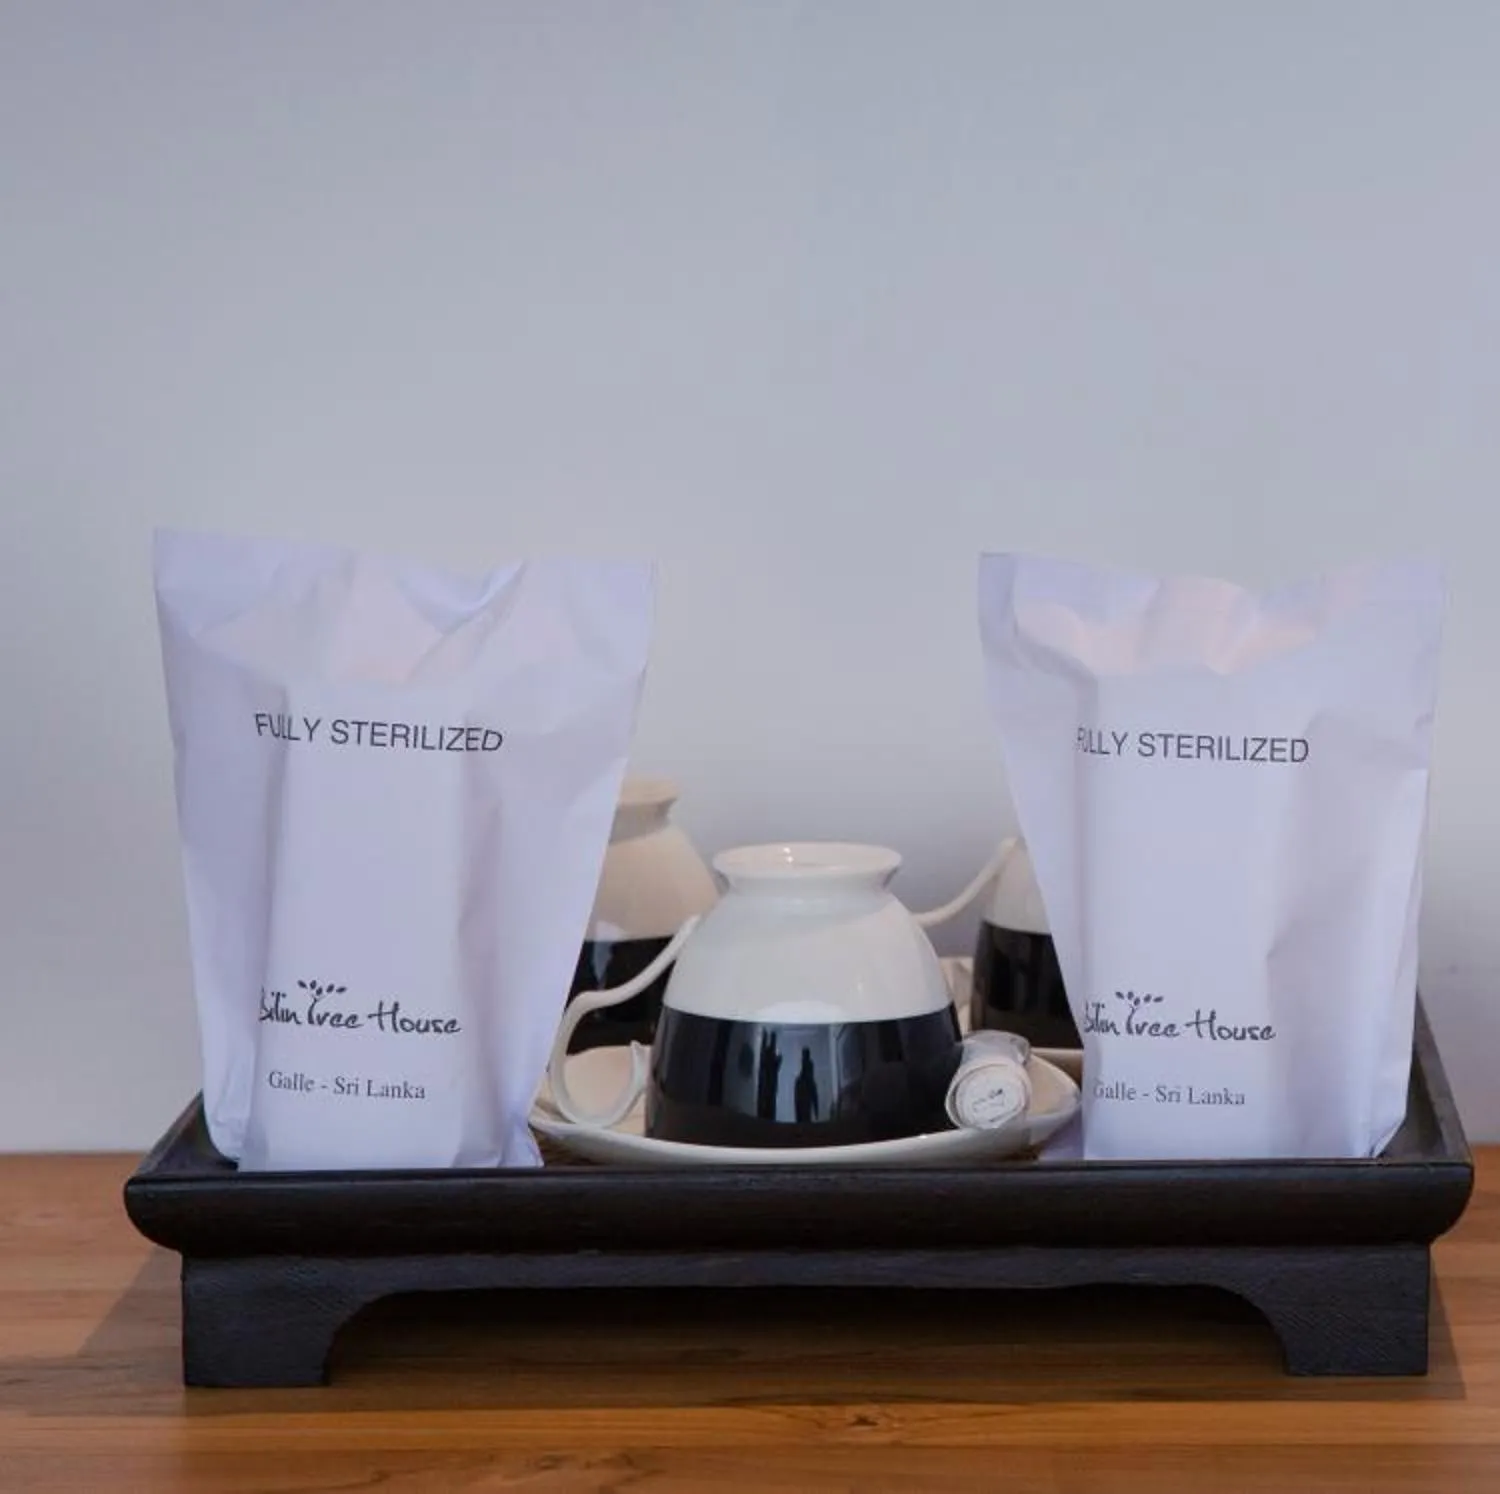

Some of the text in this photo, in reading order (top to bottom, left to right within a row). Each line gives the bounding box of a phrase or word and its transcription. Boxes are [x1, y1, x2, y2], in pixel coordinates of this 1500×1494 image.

[254, 713, 503, 751] FULLY STERILIZED
[1138, 733, 1309, 763] STERILIZED
[307, 996, 363, 1029] Tree
[367, 1000, 462, 1034] House
[1125, 1003, 1180, 1037] Tree
[1184, 1009, 1276, 1041] House
[268, 1069, 316, 1093] Galle
[333, 1075, 360, 1097] Sri
[366, 1078, 426, 1100] Lanka
[1155, 1084, 1181, 1103] Sri
[1188, 1086, 1245, 1106] Lanka
